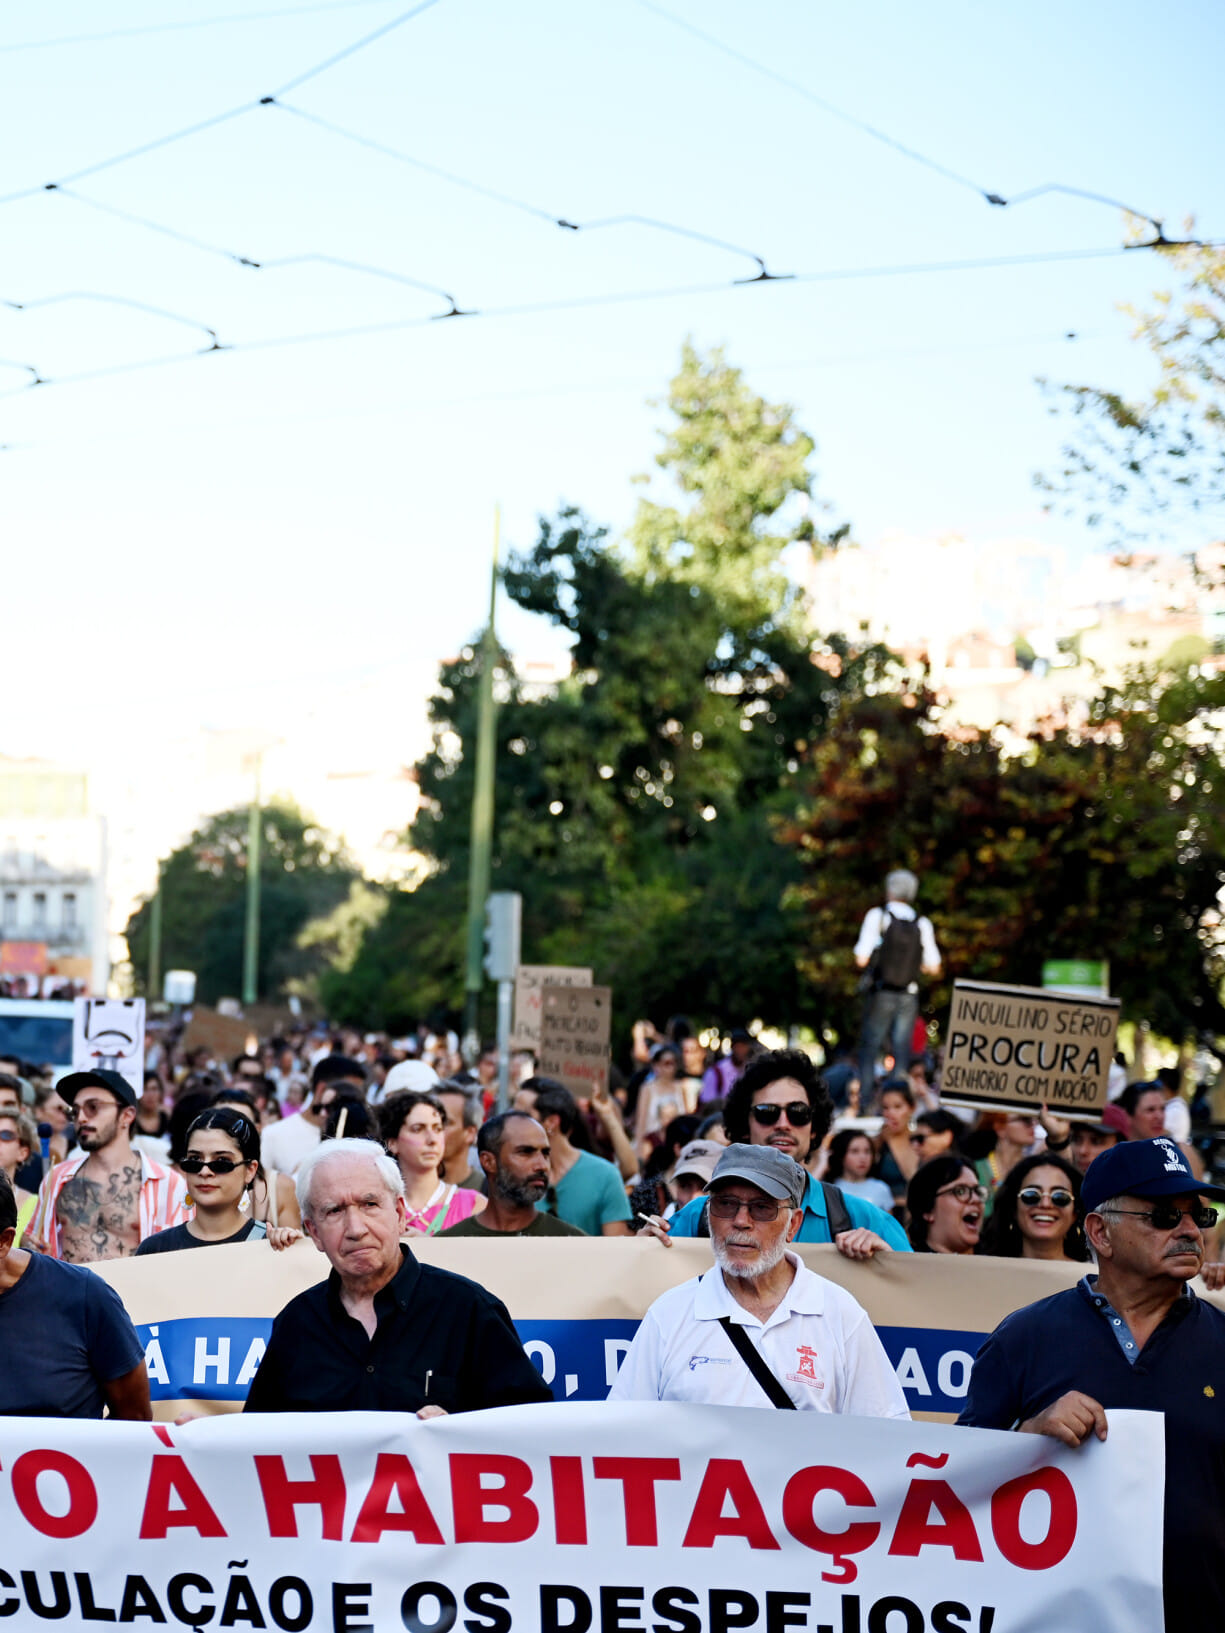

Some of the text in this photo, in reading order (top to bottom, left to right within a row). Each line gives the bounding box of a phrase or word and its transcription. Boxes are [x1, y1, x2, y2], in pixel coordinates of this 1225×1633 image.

[957, 999, 1112, 1038] INQUILINO SÉRIO
[949, 1030, 1101, 1076] PROCURA
[945, 1065, 1098, 1104] SENHORIO COM NOÇÃO
[139, 1425, 229, 1540] À
[253, 1452, 1079, 1586] HABITAÇÃO
[331, 1582, 375, 1633] E
[400, 1580, 513, 1633] OS
